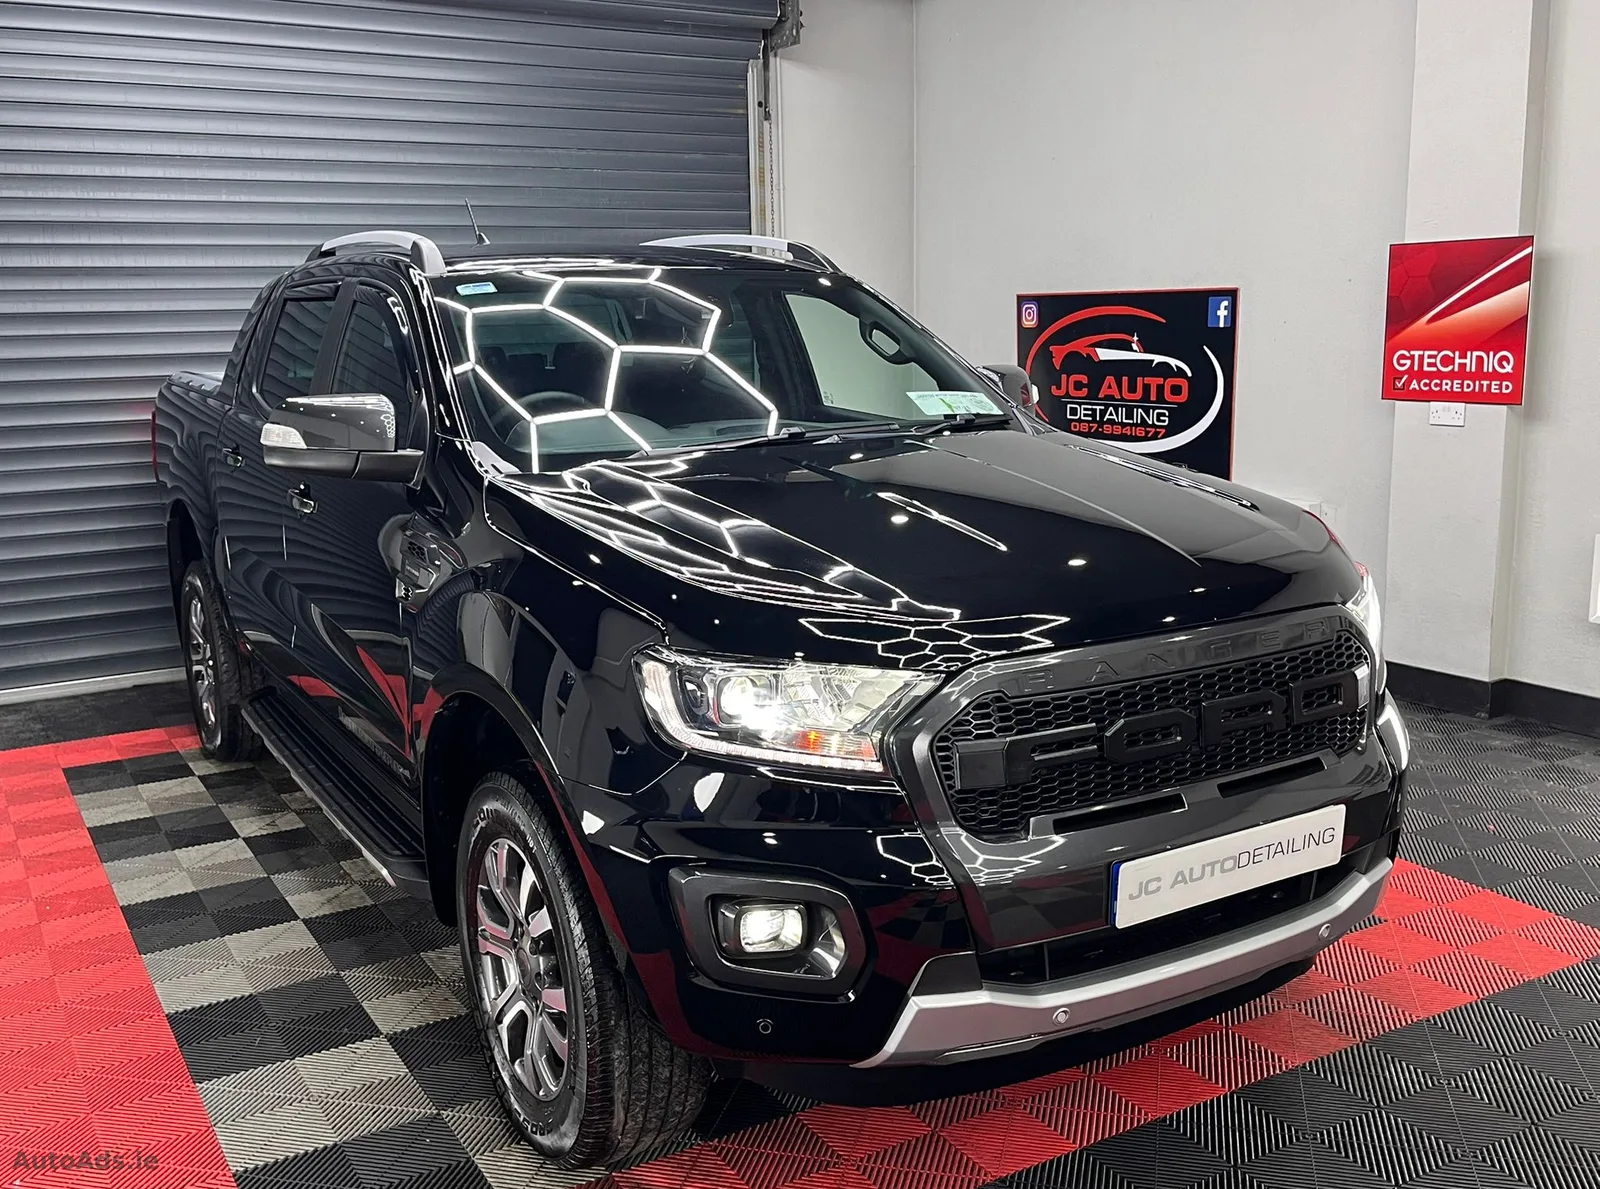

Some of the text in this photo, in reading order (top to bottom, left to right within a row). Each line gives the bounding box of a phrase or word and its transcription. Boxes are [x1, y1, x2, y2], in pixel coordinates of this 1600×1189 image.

[1392, 349, 1514, 374] GTECHNIQ
[1051, 373, 1189, 403] JC AUTO
[1408, 378, 1513, 394] ACCREDITED
[1066, 404, 1169, 426] DETAILING
[1070, 422, 1166, 438] 087-9941677
[1023, 617, 1331, 692] RANGER
[1005, 668, 1359, 786] FORD
[1128, 876, 1162, 901] JC
